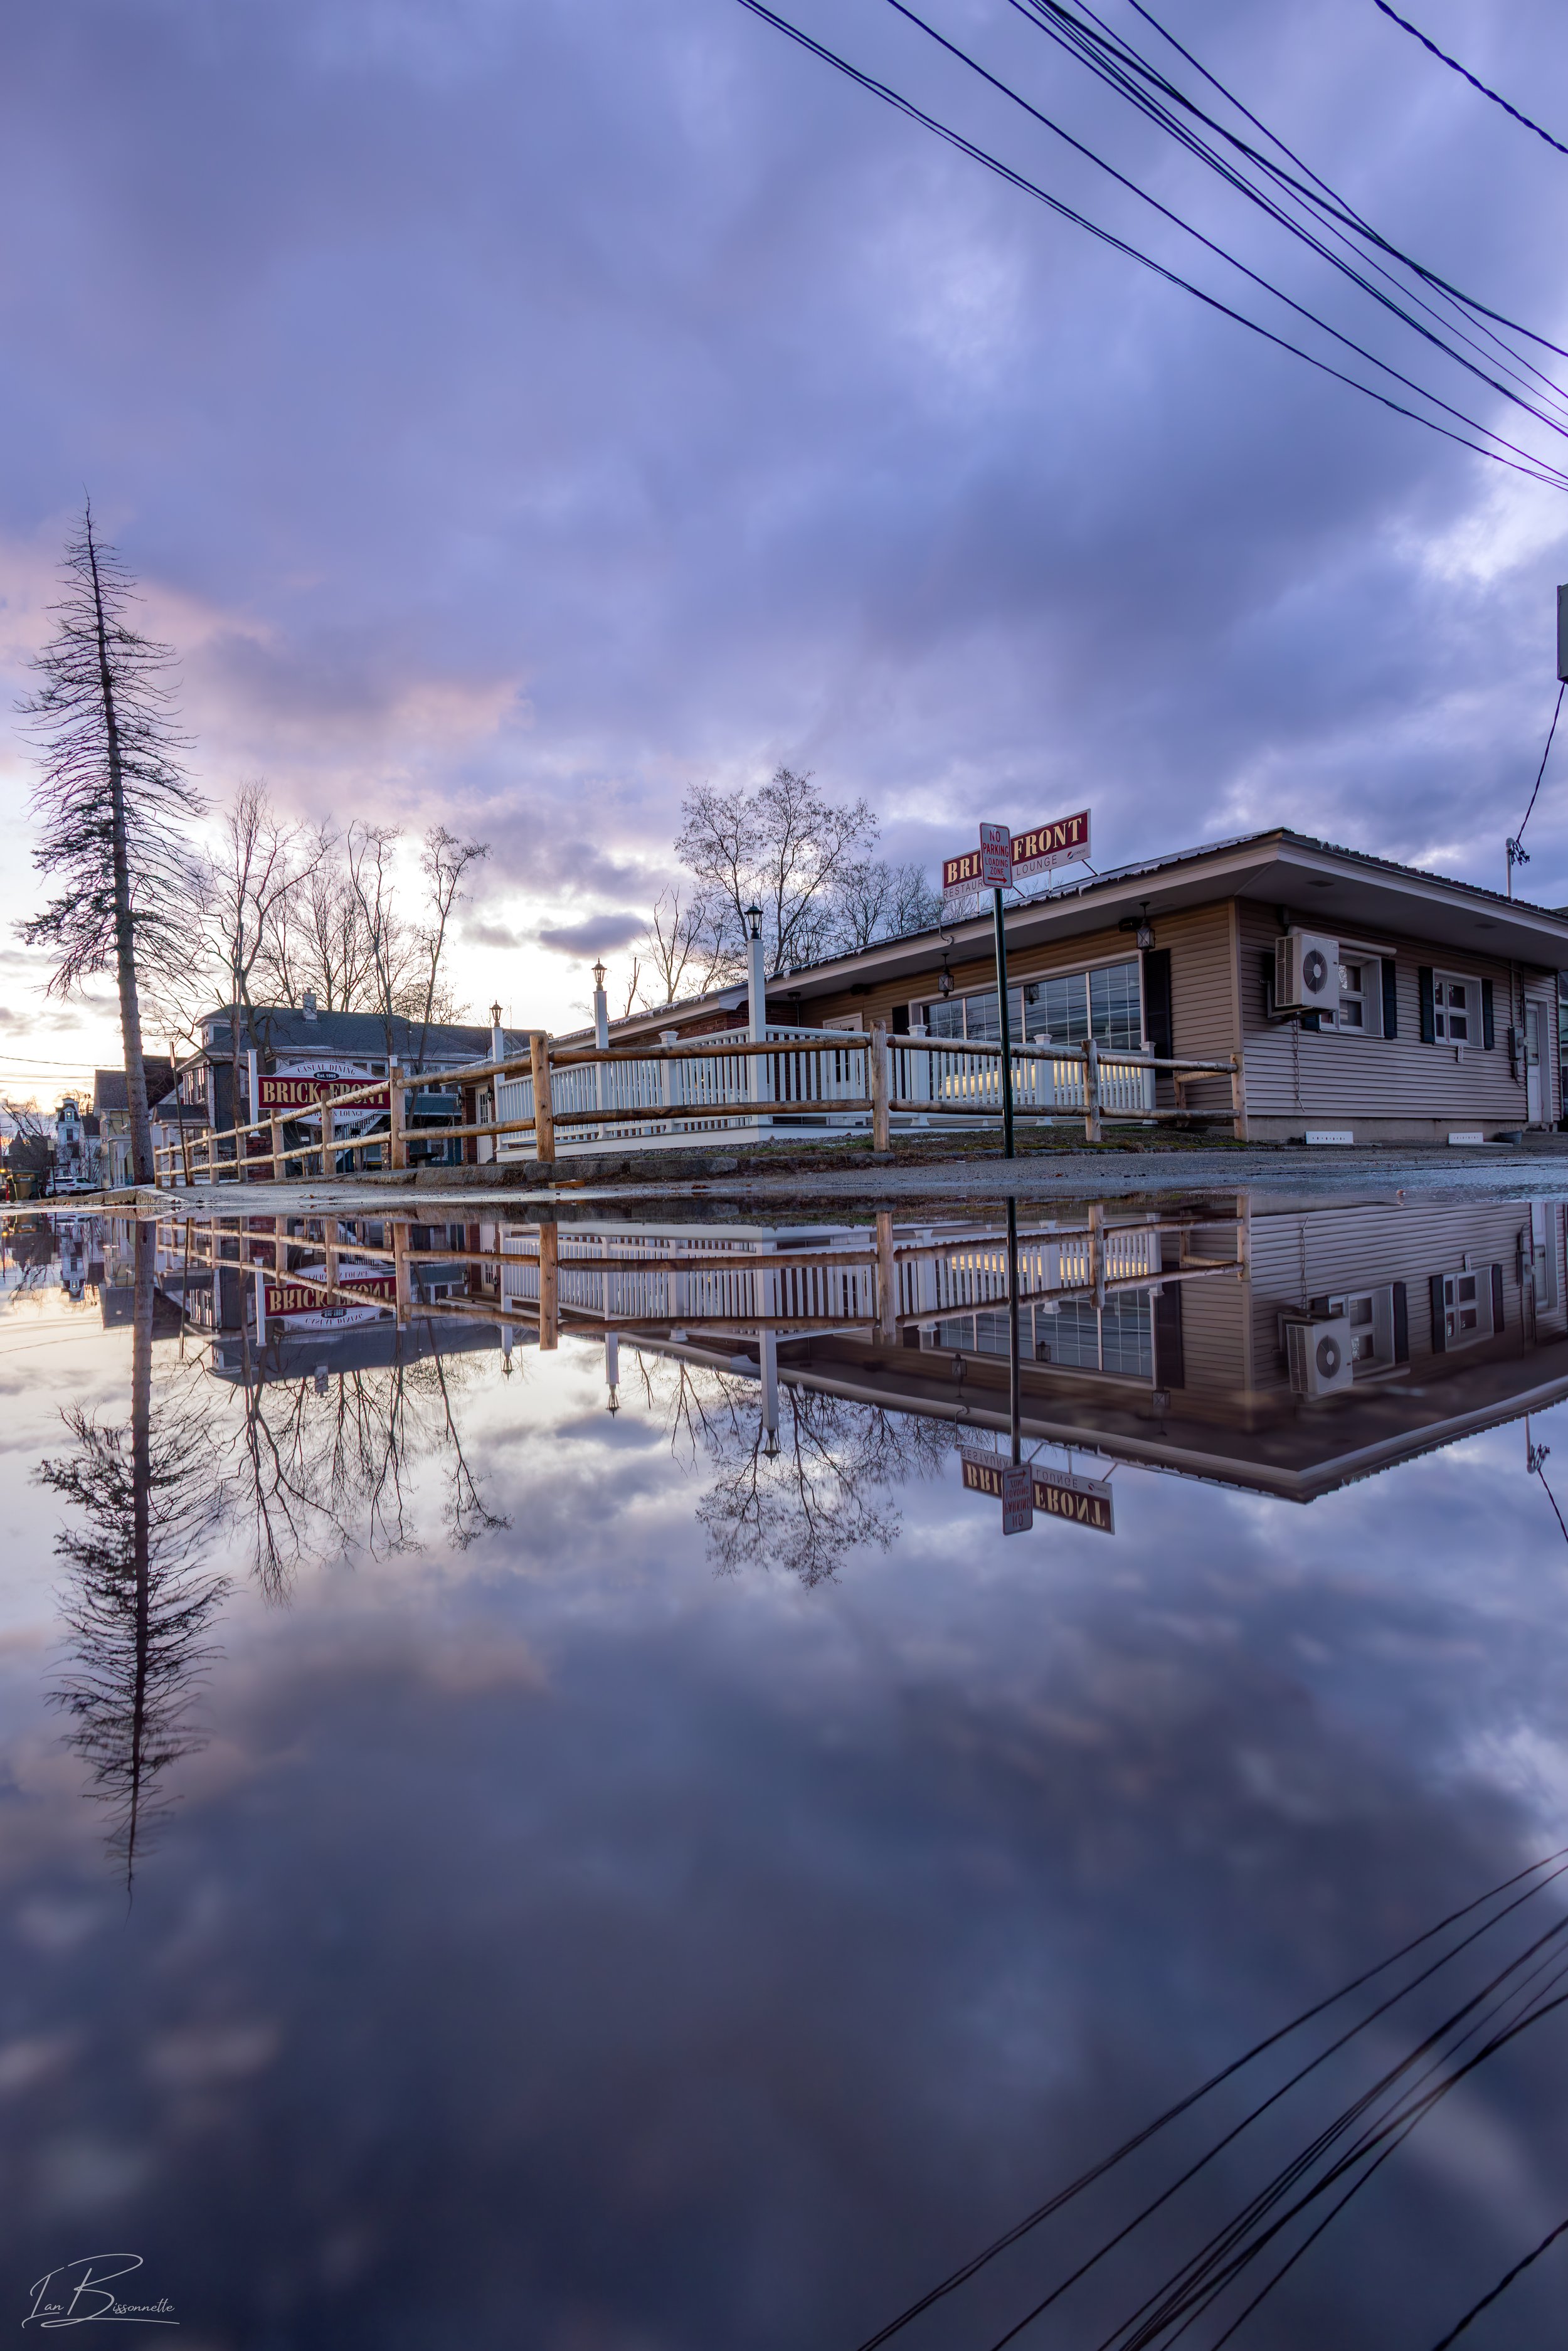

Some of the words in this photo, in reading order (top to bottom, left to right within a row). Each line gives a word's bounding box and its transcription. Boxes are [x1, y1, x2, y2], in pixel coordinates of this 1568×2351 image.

[989, 830, 1001, 842] NO
[947, 854, 982, 884] BRI
[1013, 818, 1082, 862] FRONT
[983, 842, 1009, 857] PARKING
[985, 857, 1008, 868] LOADING
[944, 879, 983, 898] RESTAUR
[1016, 854, 1057, 876] LOUNGE
[990, 867, 1004, 876] ZONE
[297, 1064, 326, 1073] CASUAL
[329, 1064, 356, 1075] DINING
[262, 1081, 321, 1103] BRICK
